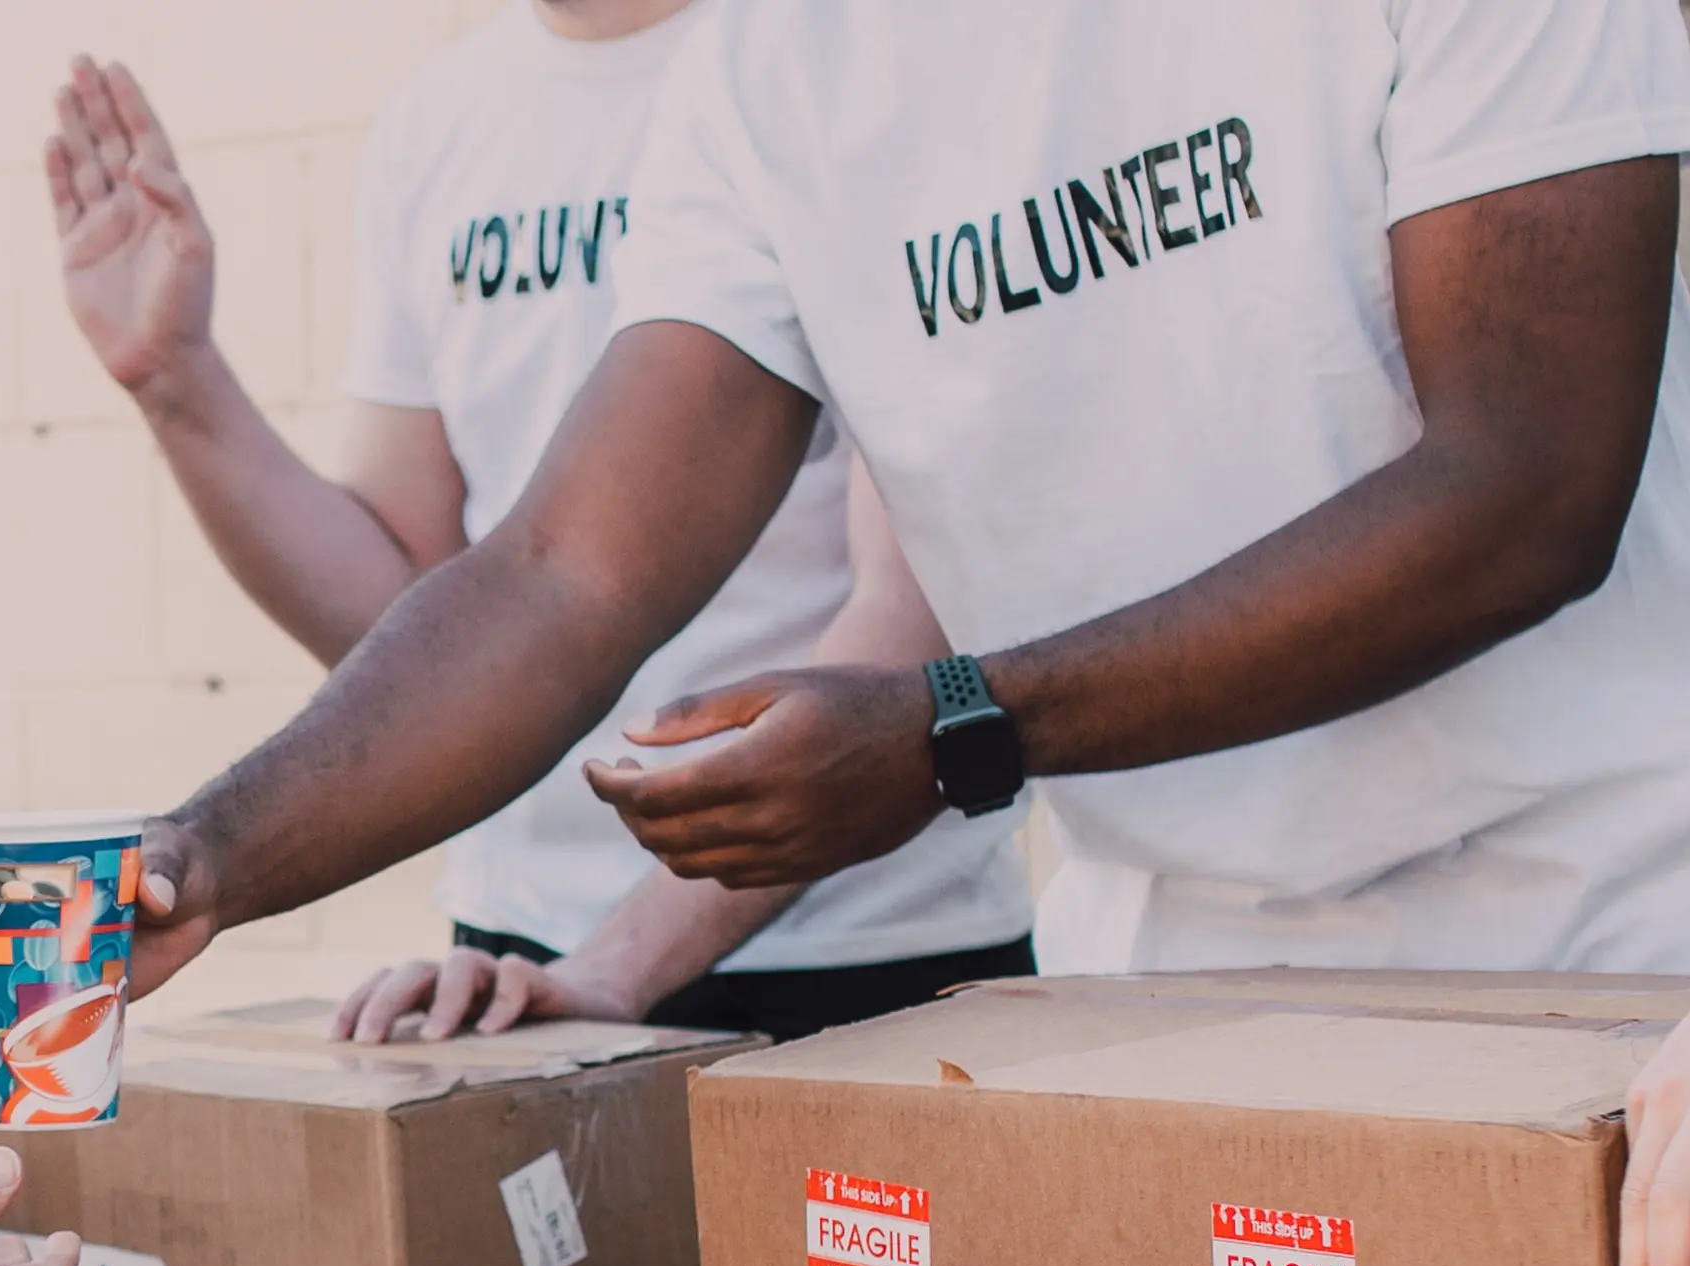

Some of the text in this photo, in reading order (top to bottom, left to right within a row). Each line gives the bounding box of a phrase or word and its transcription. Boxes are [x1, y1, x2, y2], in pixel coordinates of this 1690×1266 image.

[905, 116, 1263, 338] VOLUNTEER
[840, 1184, 895, 1208] THIS SIDE UP
[819, 1217, 920, 1266] FRAGILE
[1251, 1220, 1315, 1240] THIS SIDE UP
